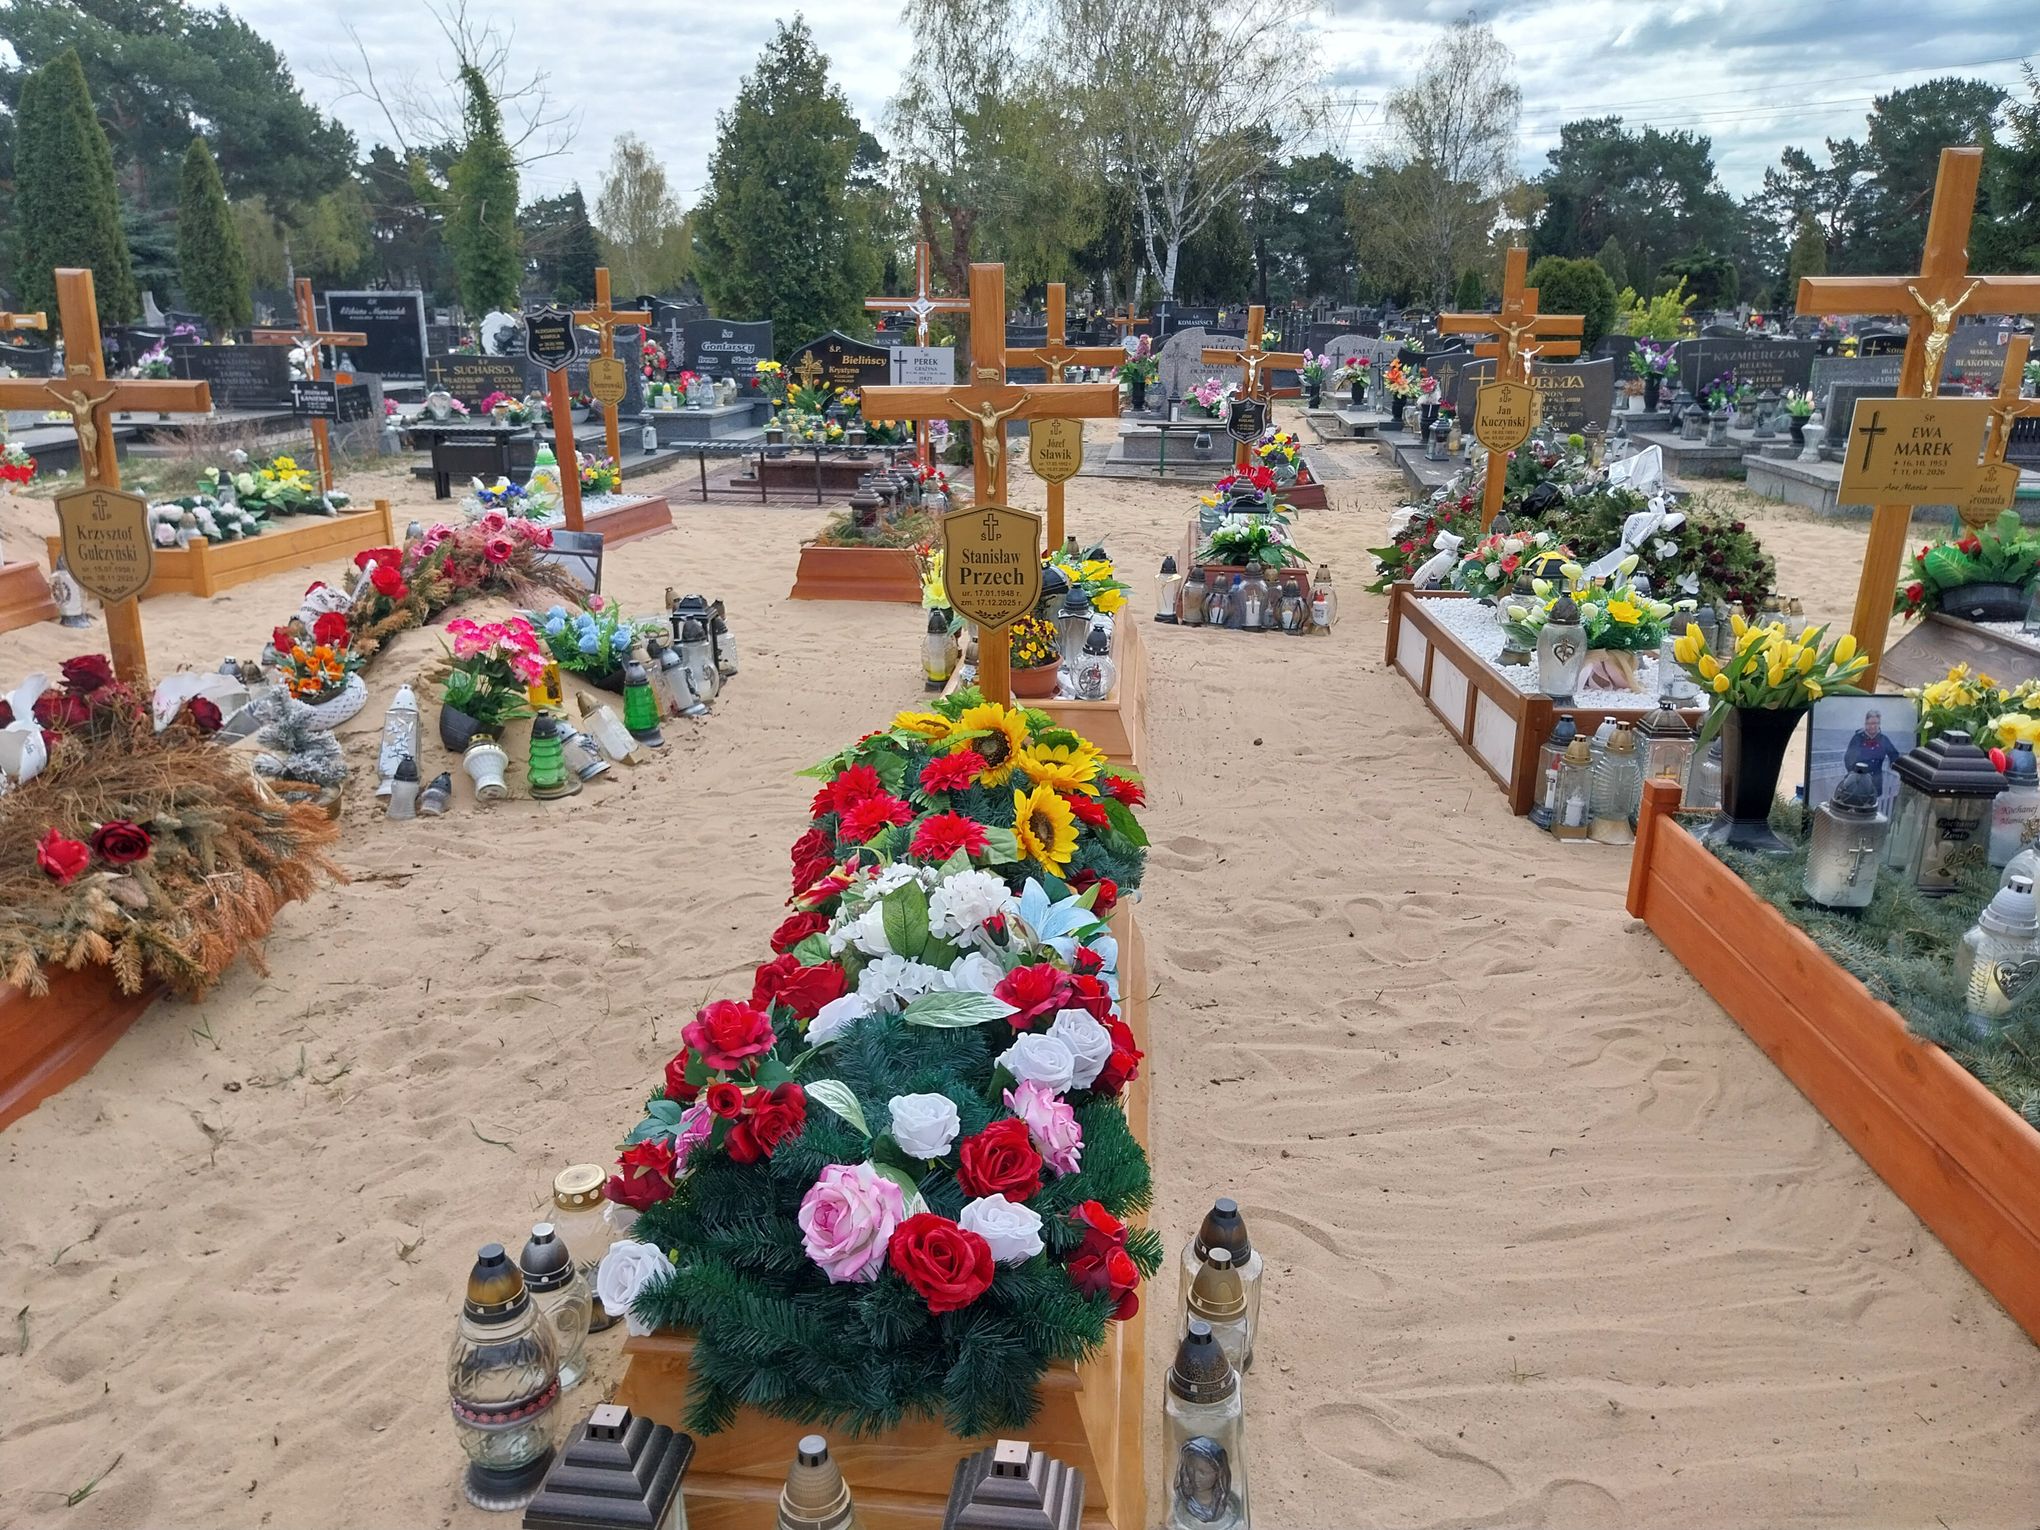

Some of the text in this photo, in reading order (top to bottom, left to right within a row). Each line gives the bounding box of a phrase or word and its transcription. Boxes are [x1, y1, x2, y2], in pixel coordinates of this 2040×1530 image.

[701, 341, 755, 354] Gontarscy
[842, 355, 887, 366] Bielińscy
[914, 358, 938, 366] PEREK
[453, 364, 516, 375] SUCHARSCY
[1496, 405, 1512, 415] Jan
[1481, 416, 1526, 430] Kuczyński
[1912, 427, 1942, 438] EWA
[1894, 442, 1953, 456] MAREK
[77, 525, 132, 544] Krzysztof
[996, 533, 1002, 541] P
[78, 543, 137, 565] Gulczyński
[962, 548, 1020, 564] Stanisław
[960, 567, 1024, 585] Przech
[977, 599, 1016, 607] 17.12.2025
